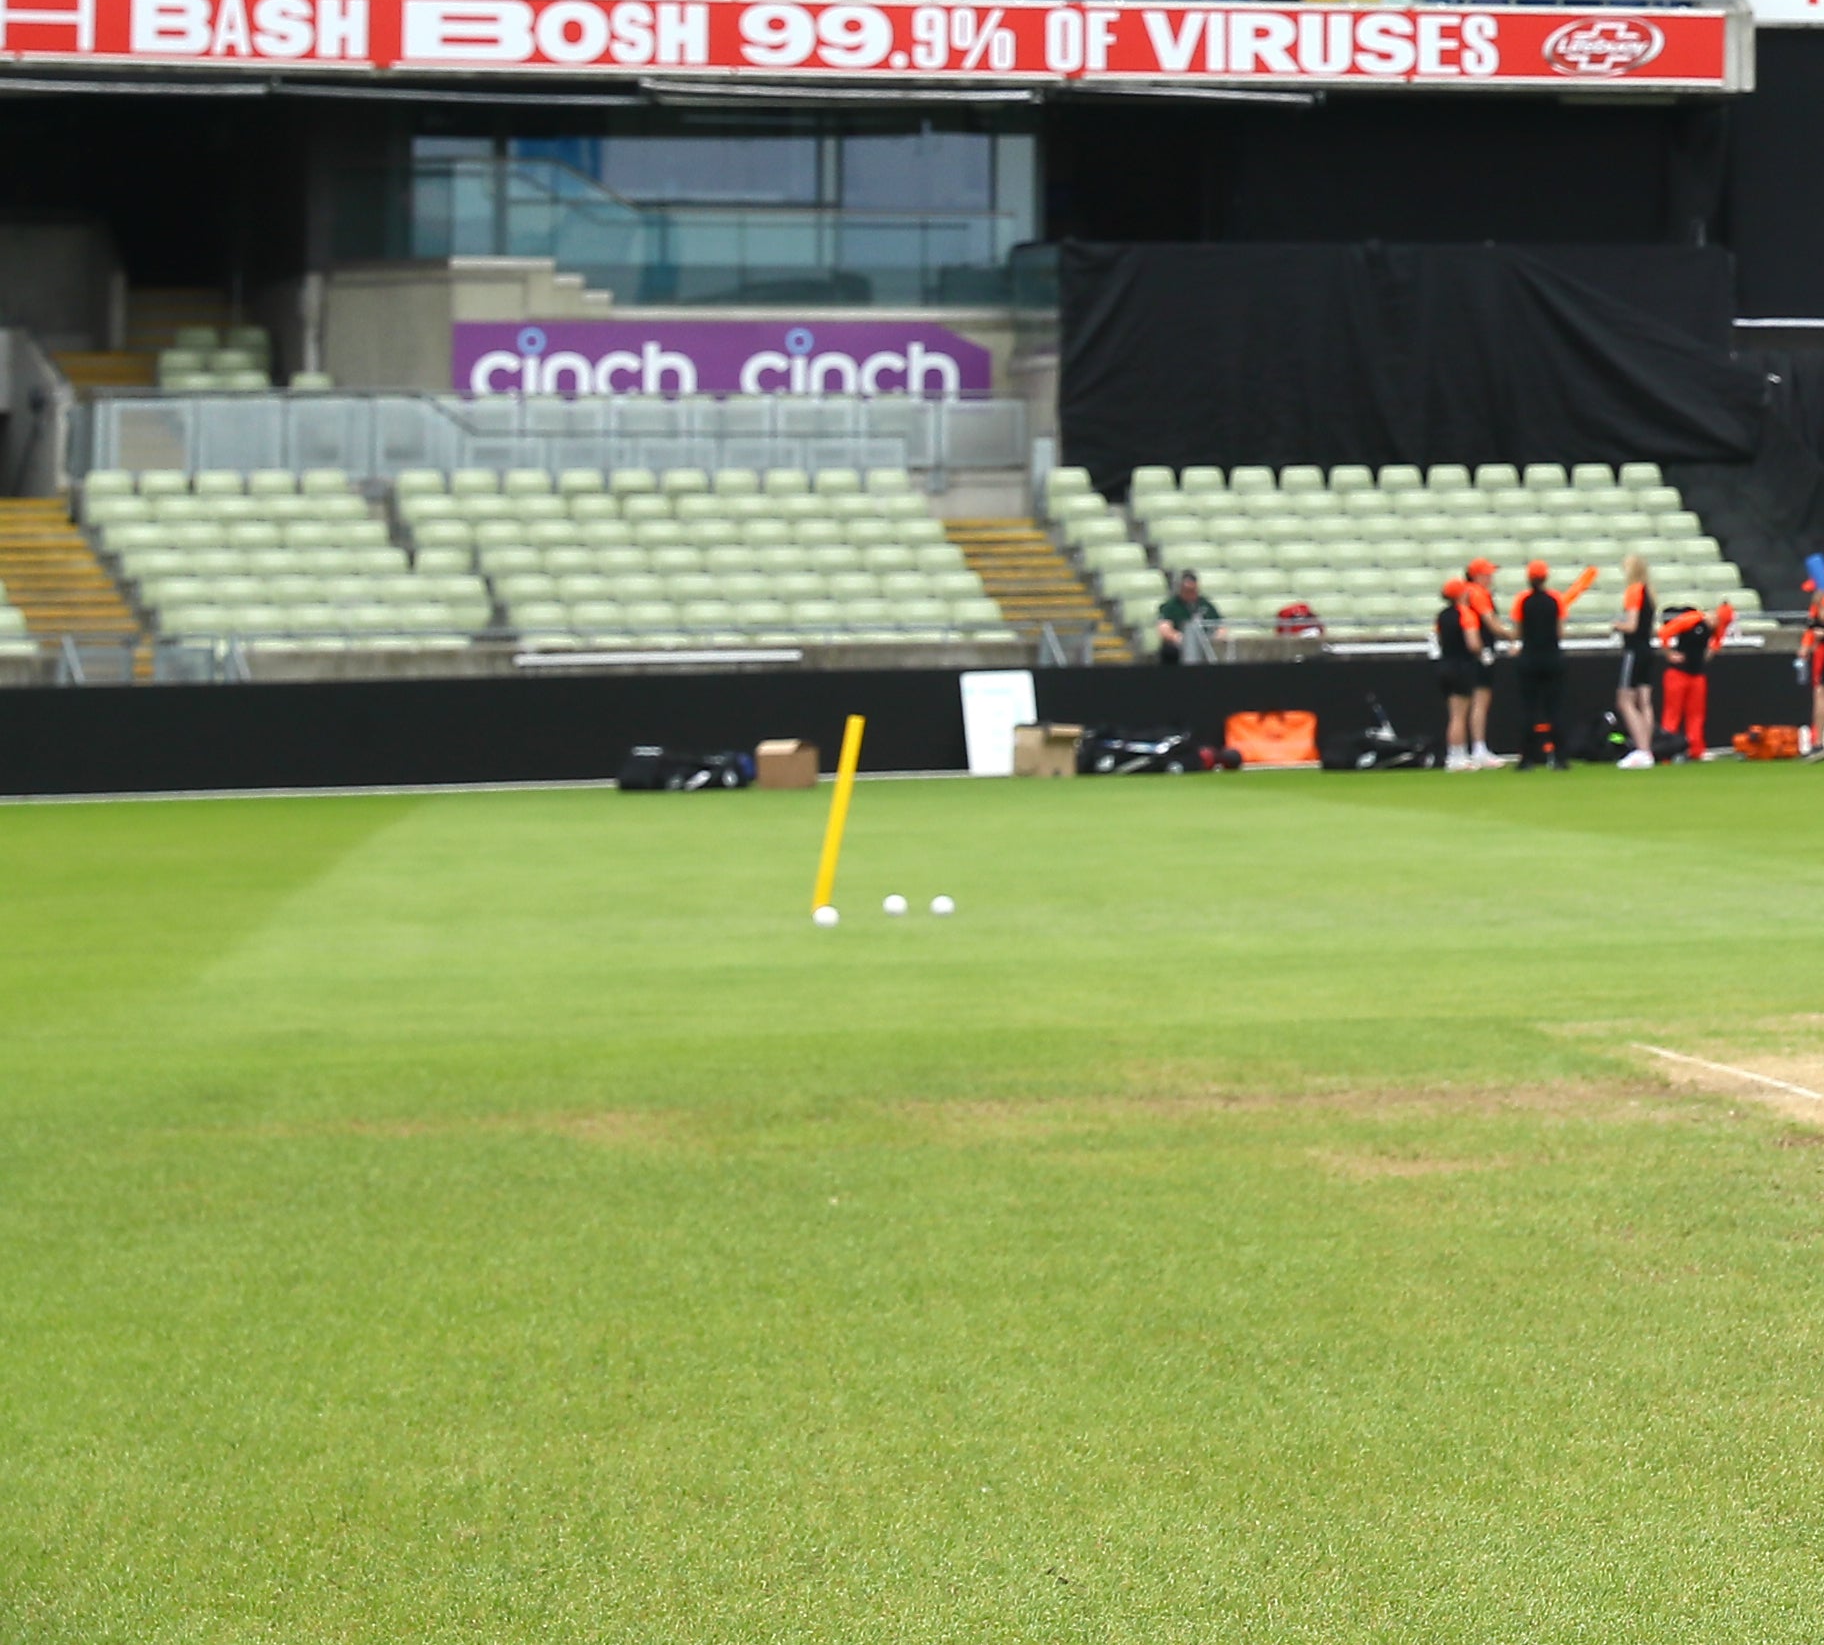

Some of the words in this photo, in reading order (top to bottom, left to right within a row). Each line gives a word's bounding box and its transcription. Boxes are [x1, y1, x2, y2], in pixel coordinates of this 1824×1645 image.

[738, 4, 1016, 70] 99.9%
[1044, 9, 1119, 71] OF
[1143, 10, 1498, 76] VIRUSES
[470, 327, 697, 396] cinch
[739, 327, 960, 398] cinch
